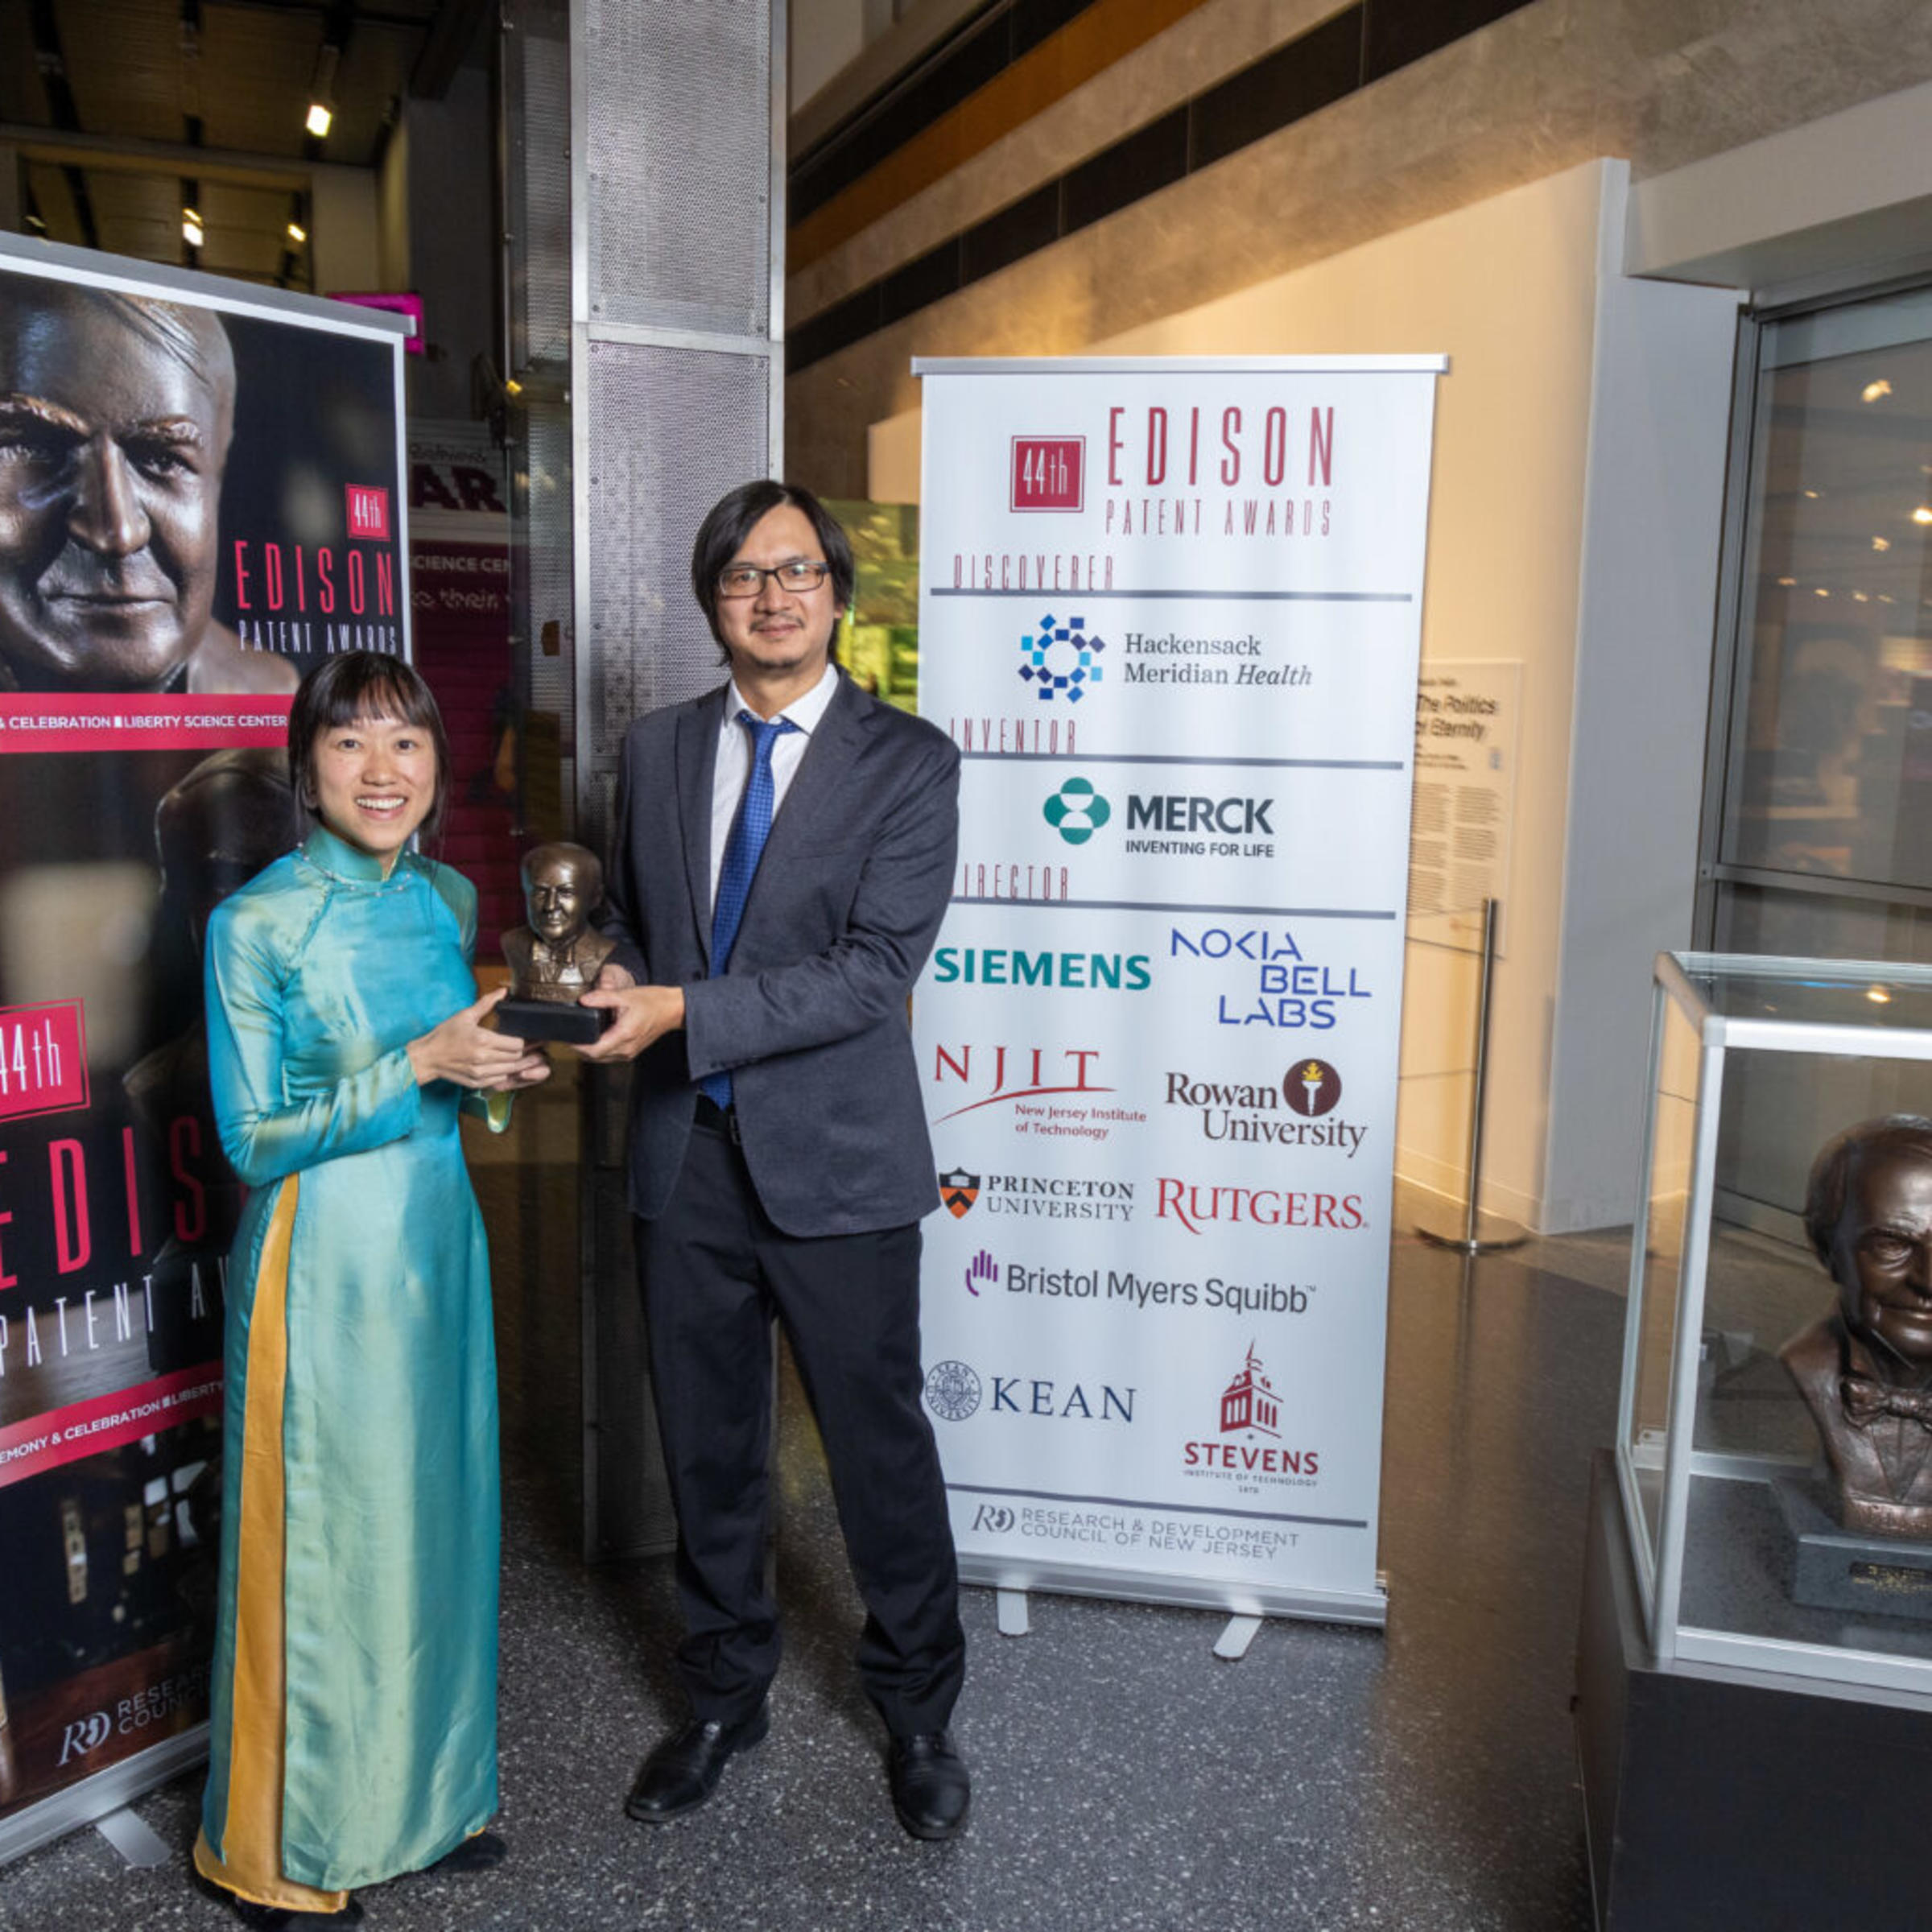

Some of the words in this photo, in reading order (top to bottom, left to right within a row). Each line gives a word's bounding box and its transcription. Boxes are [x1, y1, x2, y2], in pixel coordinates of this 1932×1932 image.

[1108, 407, 1335, 487] EDISON
[1023, 448, 1067, 495] 44th
[353, 493, 382, 529] 44th
[1106, 499, 1203, 536] PATENT
[1224, 500, 1331, 537] AWARDS
[235, 540, 394, 617] EDISON
[412, 554, 477, 572] CIENCE
[953, 555, 1114, 591] DISCOVERER
[239, 621, 312, 654] PATENT
[327, 623, 397, 655] AWARDS
[1125, 633, 1262, 656] Hackensack
[1124, 663, 1229, 685] Meridian
[1235, 665, 1314, 687] Health
[10, 716, 111, 729] CELEBRATION
[124, 715, 180, 728] LIBERTY
[184, 714, 236, 727] SCIENCE
[238, 714, 287, 727] CENTER
[950, 717, 1076, 754] INVENTOR
[1126, 795, 1276, 835] MERCK
[1125, 840, 1206, 857] INVENTING
[1209, 842, 1240, 857] FOR
[1243, 843, 1276, 858] LIFE
[953, 863, 1070, 901] IRECTOR
[1170, 927, 1303, 961] NOKIA
[934, 947, 1152, 991] SIEMENS
[1260, 965, 1373, 997] BELL
[1218, 995, 1336, 1030] LABS
[933, 1043, 1100, 1096] NJIT
[1165, 1071, 1278, 1110] Rowan
[1014, 1104, 1045, 1117] New
[1047, 1104, 1088, 1122] Jersey
[1091, 1107, 1146, 1123] Institute
[1014, 1121, 1030, 1134] of
[1033, 1122, 1109, 1140] Technology
[1202, 1109, 1368, 1158] University
[0, 1115, 208, 1292] EDIS
[987, 1174, 1134, 1200] PRINCETON
[987, 1195, 1134, 1222] UNIVERSITY
[1155, 1177, 1364, 1235] RUTGERS
[1006, 1263, 1099, 1298] Bristol
[1107, 1271, 1198, 1308] Myers
[0, 1274, 154, 1377] PATENT
[990, 1377, 1137, 1422] KEAN
[51, 1431, 62, 1446] &
[64, 1400, 161, 1441] CELEBRATION
[1183, 1442, 1319, 1476] STEVENS
[1183, 1470, 1233, 1481] INSTITUTE
[1236, 1473, 1249, 1481] OF
[1253, 1475, 1318, 1487] TECHNOLOGY
[1021, 1524, 1108, 1544] COUNCIL
[1116, 1532, 1140, 1546] OF
[1148, 1535, 1195, 1552] NEW
[1202, 1538, 1278, 1560] JERSEY
[1022, 1508, 1125, 1530] RESEARCH
[1132, 1518, 1143, 1532] &
[1151, 1519, 1300, 1547] DEVELOPMENT
